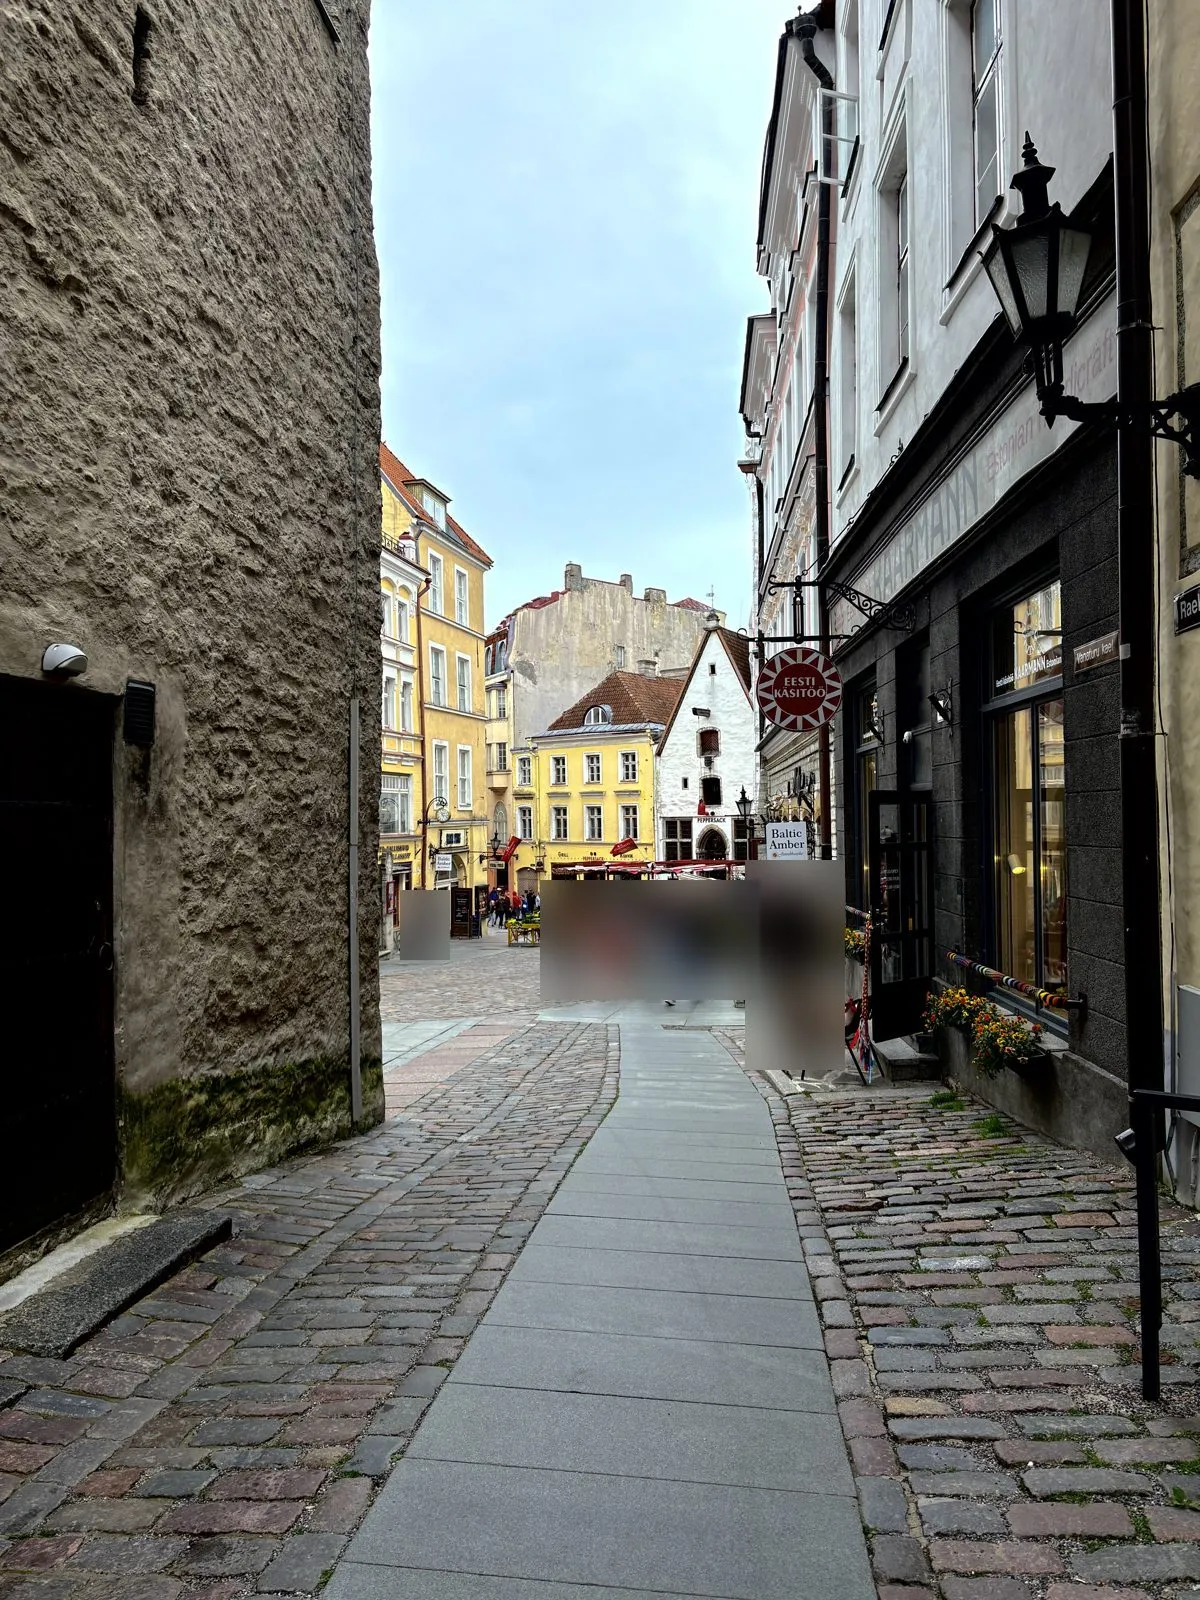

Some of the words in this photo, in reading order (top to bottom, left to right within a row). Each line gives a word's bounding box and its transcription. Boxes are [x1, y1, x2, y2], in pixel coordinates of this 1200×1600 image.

[873, 452, 978, 600] KAARMANN
[1076, 648, 1100, 664] Vanaturu
[1101, 639, 1114, 655] kael
[1014, 655, 1046, 680] KAARMANN
[784, 677, 815, 687] EESTI
[774, 686, 826, 698] KÄSITÖÖ
[771, 829, 802, 839] Baltic
[769, 840, 805, 850] Amber
